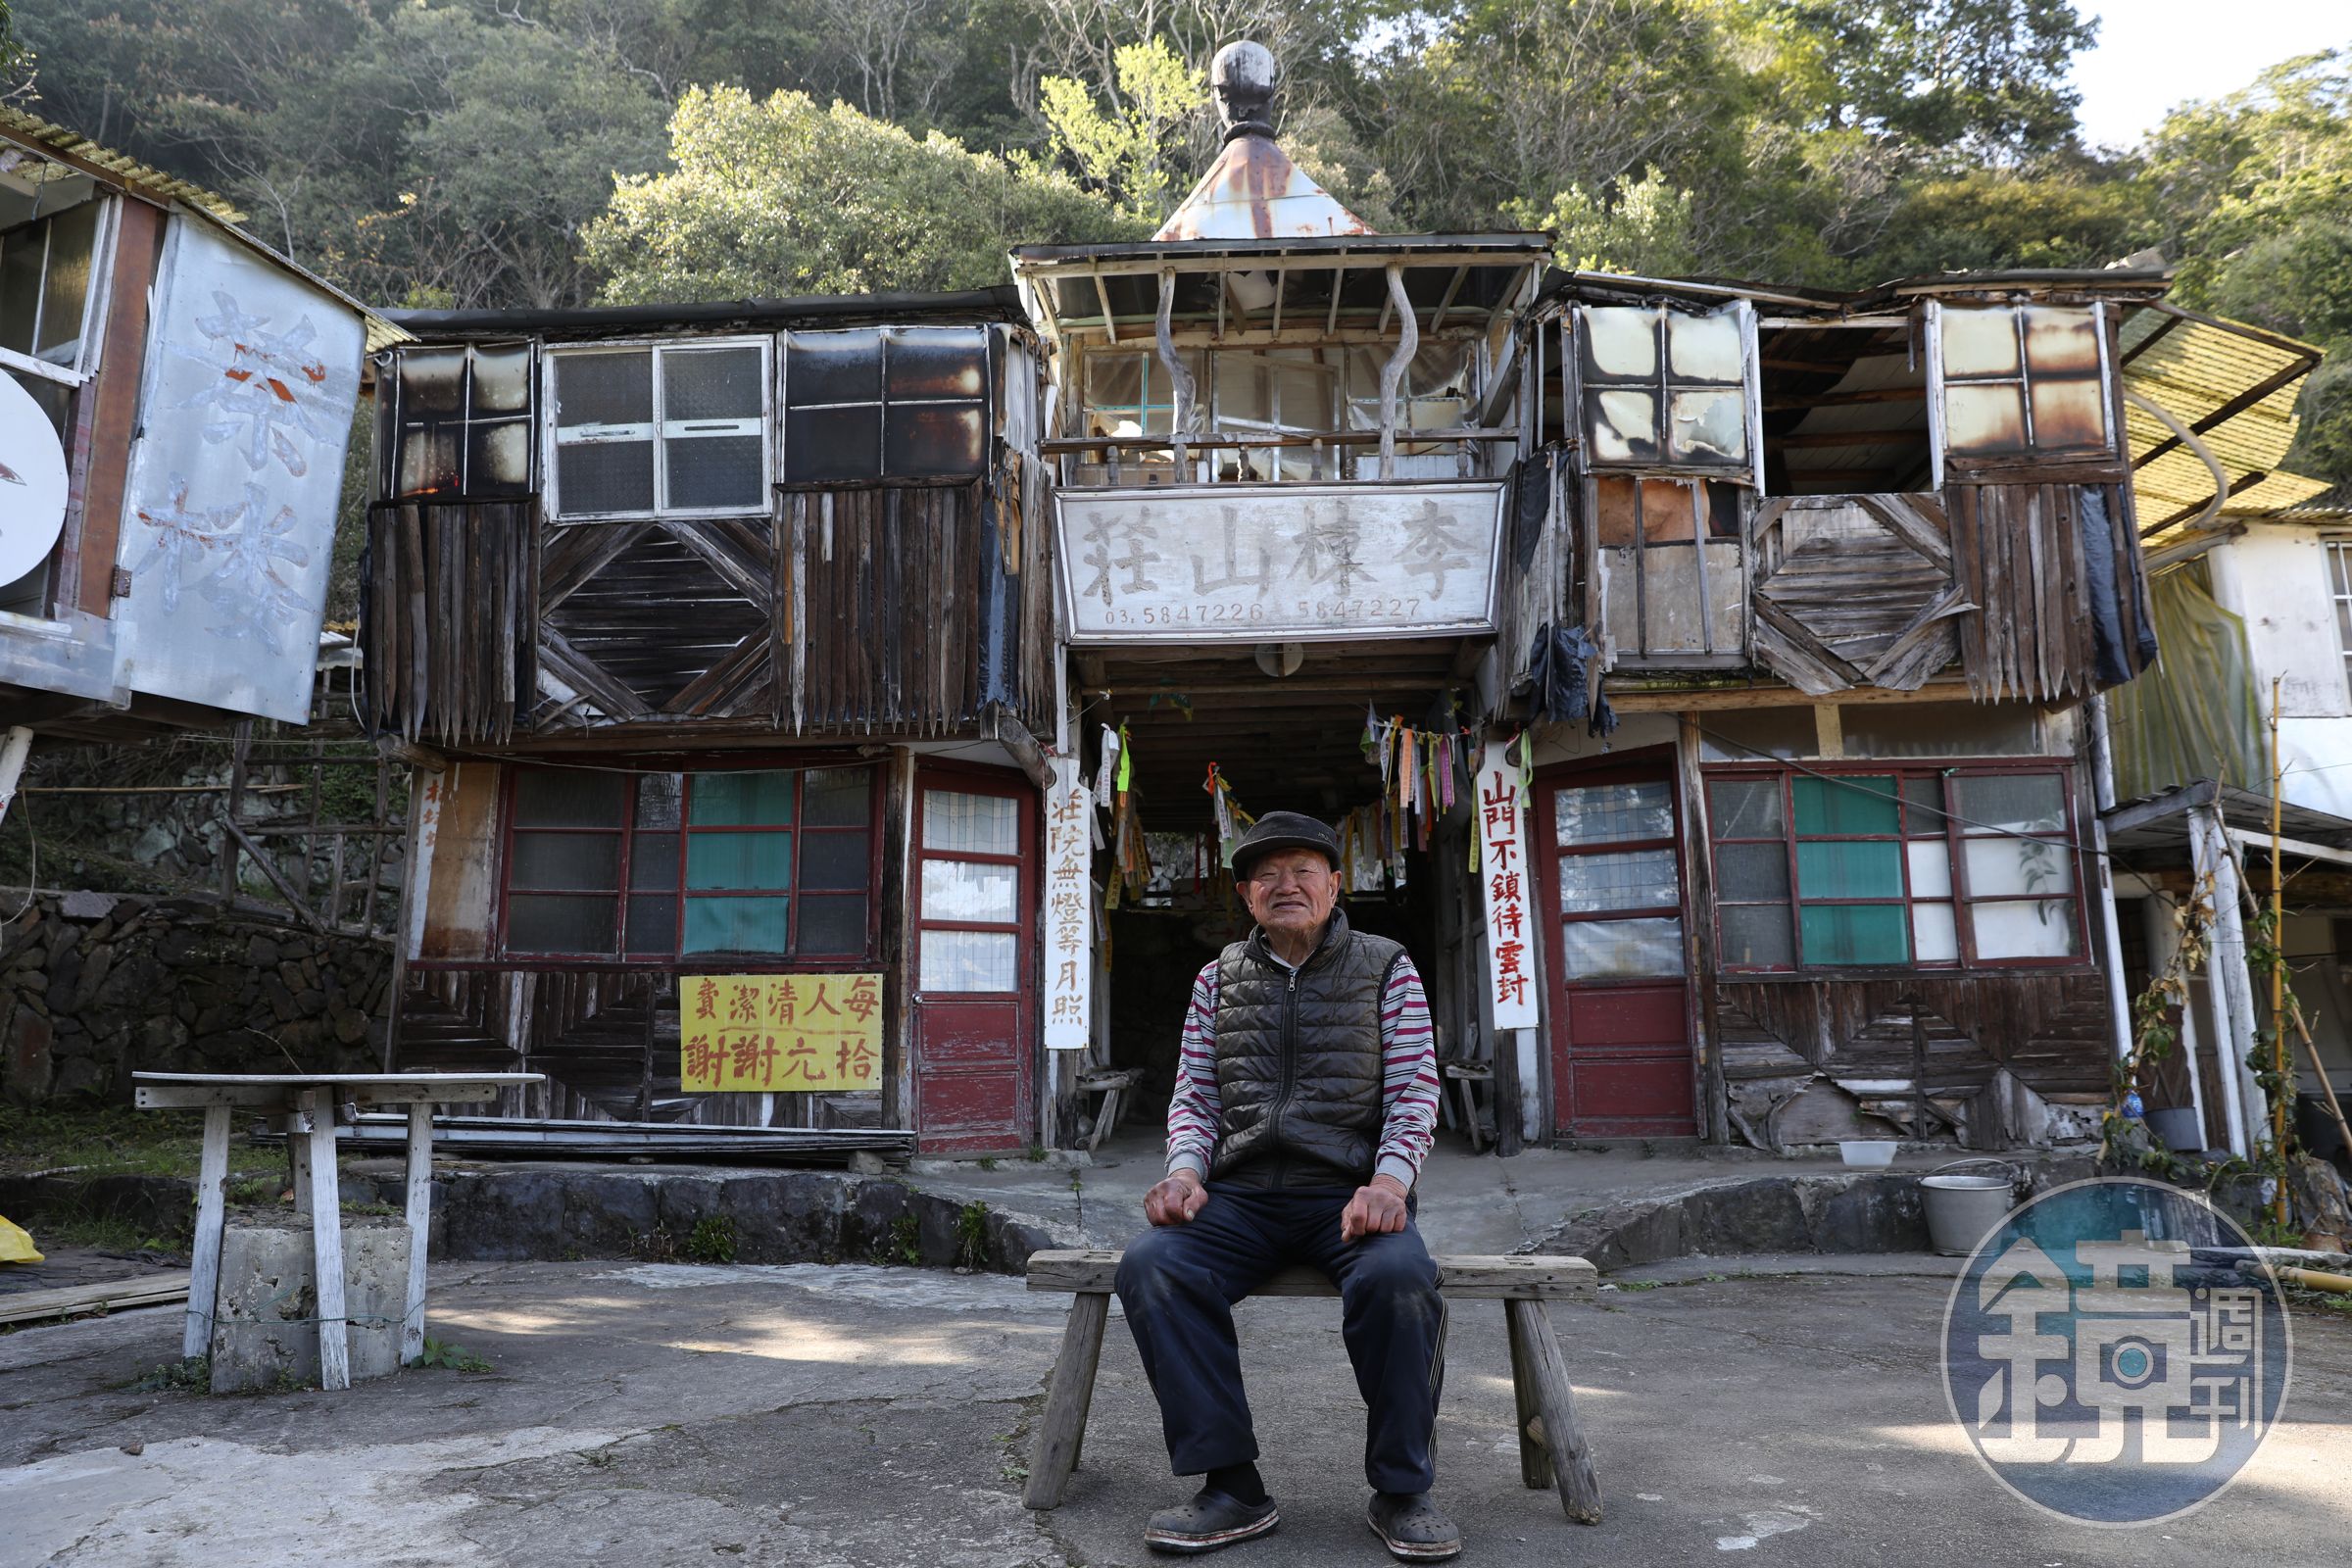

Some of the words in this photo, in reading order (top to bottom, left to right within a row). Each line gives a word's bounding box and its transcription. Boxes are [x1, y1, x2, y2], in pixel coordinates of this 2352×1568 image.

[1482, 770, 1529, 1005] 山門不鎖待雲封
[696, 975, 880, 1025] 每人清潔費
[682, 1033, 879, 1088] 拾元謝謝
